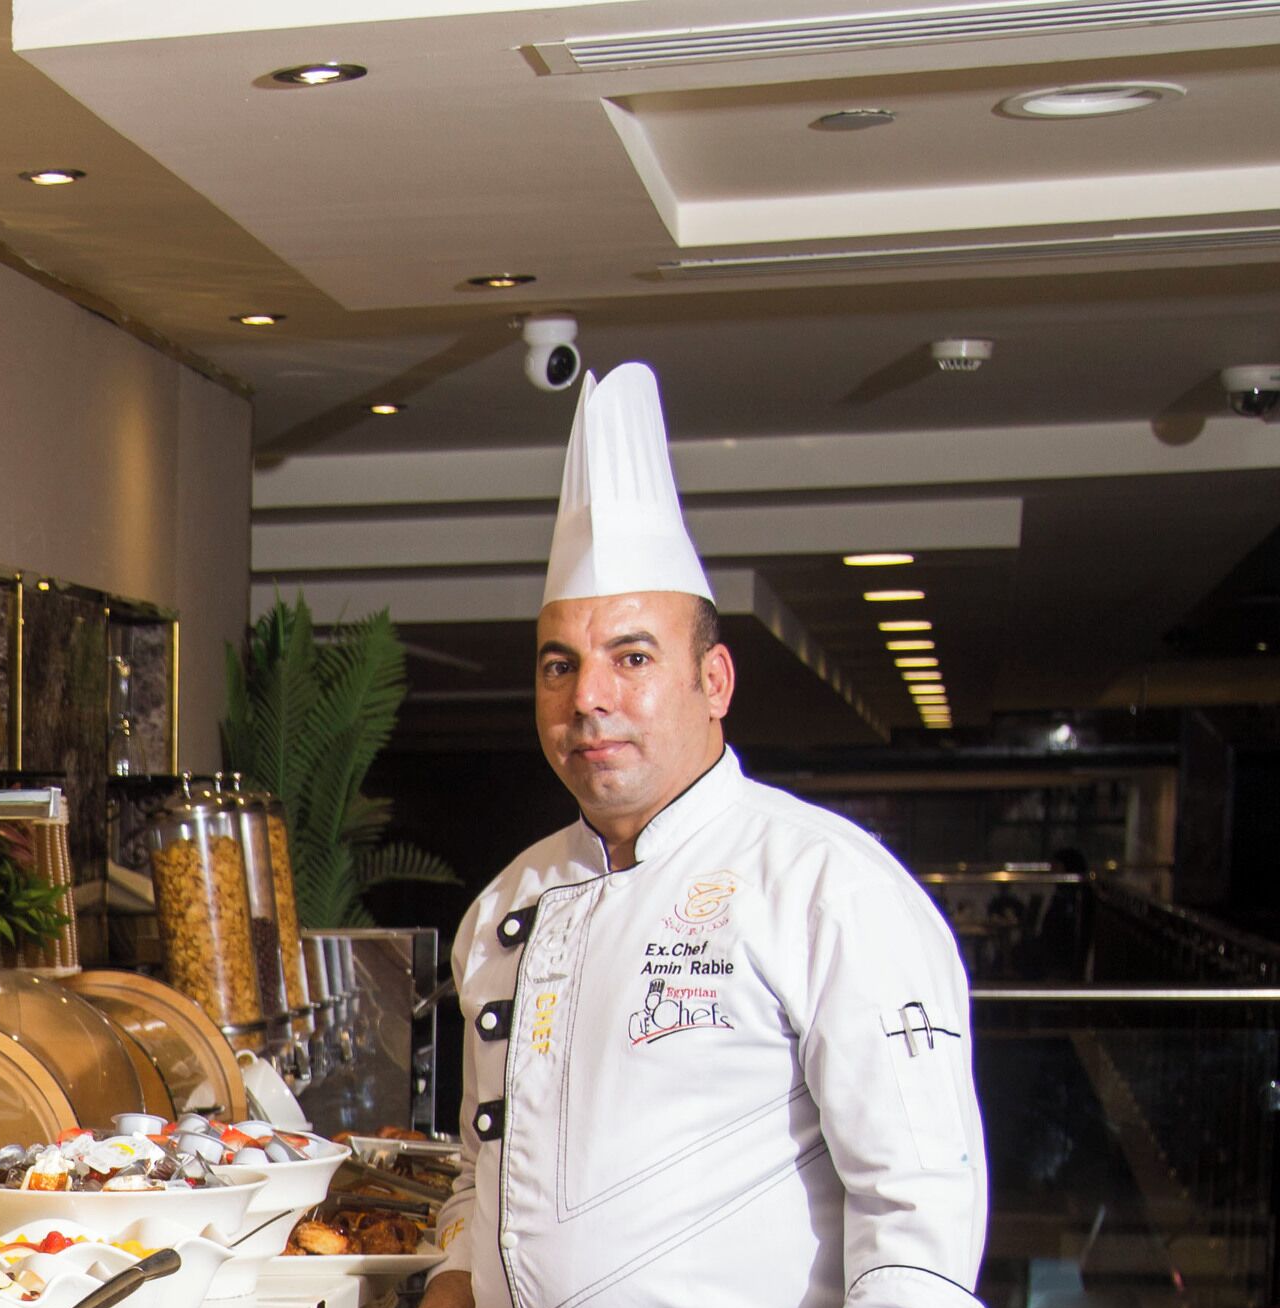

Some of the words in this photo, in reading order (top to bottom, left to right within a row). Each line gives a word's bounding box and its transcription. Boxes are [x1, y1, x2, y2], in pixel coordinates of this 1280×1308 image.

[644, 941, 709, 957] Ex.Chef
[640, 961, 682, 975] Amin
[690, 959, 735, 975] Rabie
[666, 986, 718, 999] Egyptian
[651, 999, 733, 1031] Chefs
[530, 992, 558, 1055] CHEF
